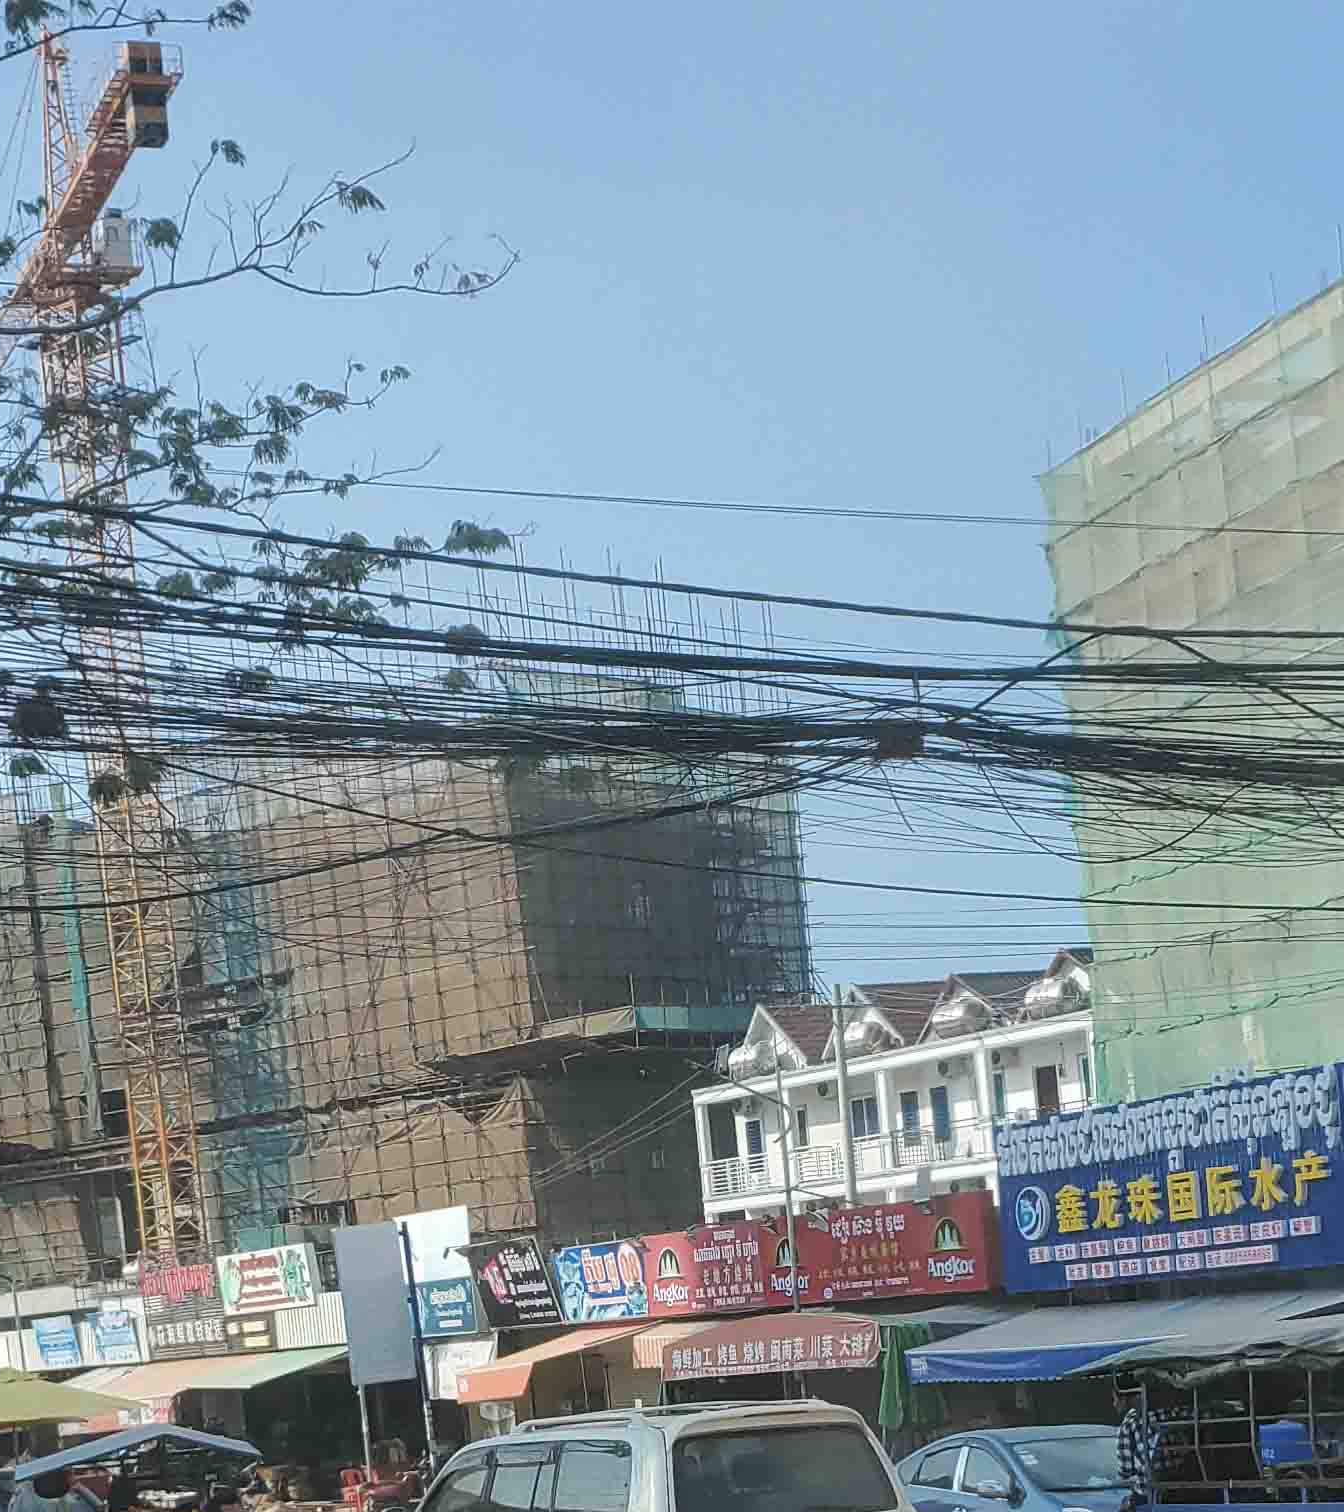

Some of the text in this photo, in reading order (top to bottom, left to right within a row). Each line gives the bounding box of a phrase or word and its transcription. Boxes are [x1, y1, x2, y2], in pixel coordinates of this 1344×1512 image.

[1056, 1152, 1330, 1233] 鑫龙珠国际水产
[928, 1256, 976, 1282] Angkor
[810, 1334, 833, 1359] 川菜
